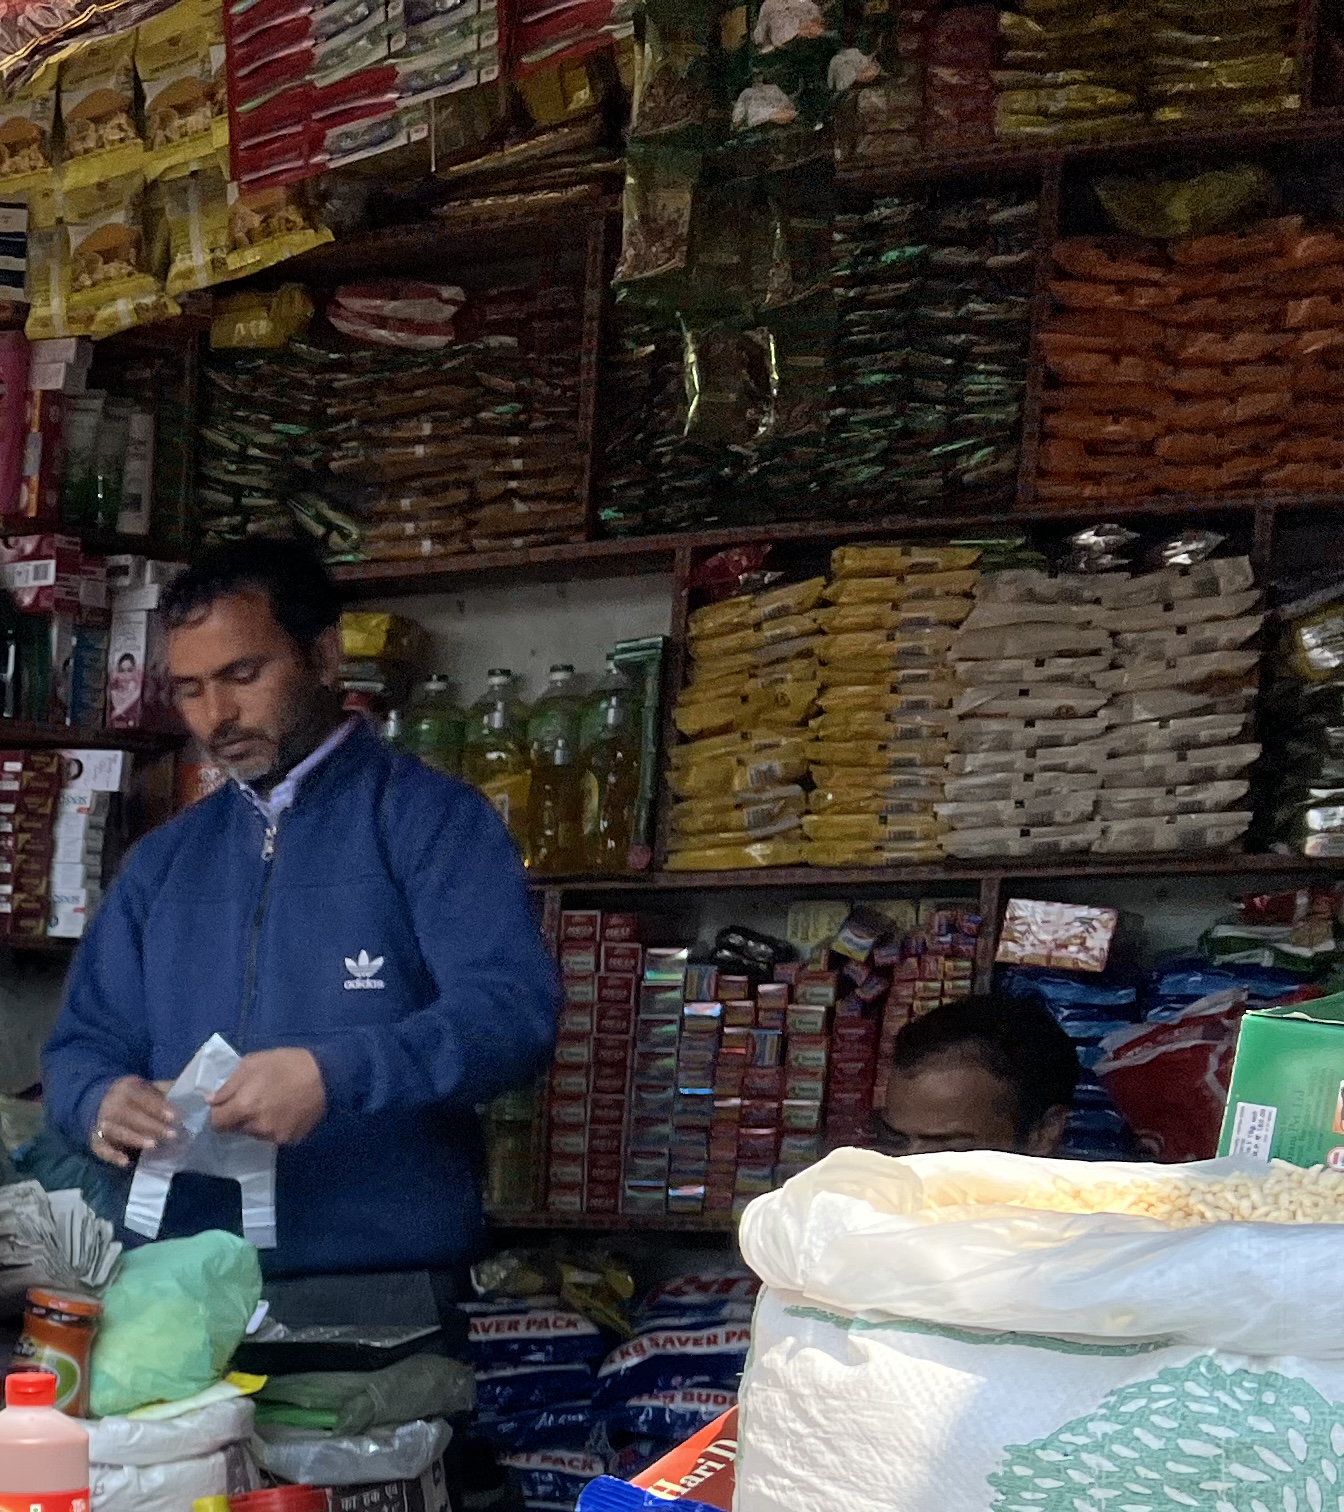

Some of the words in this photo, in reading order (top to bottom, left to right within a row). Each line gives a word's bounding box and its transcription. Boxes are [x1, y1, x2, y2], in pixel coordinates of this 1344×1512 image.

[343, 978, 385, 990] adidas
[524, 1317, 579, 1333] PACK
[648, 1330, 718, 1351] SAVER
[648, 1455, 727, 1502] Hari
